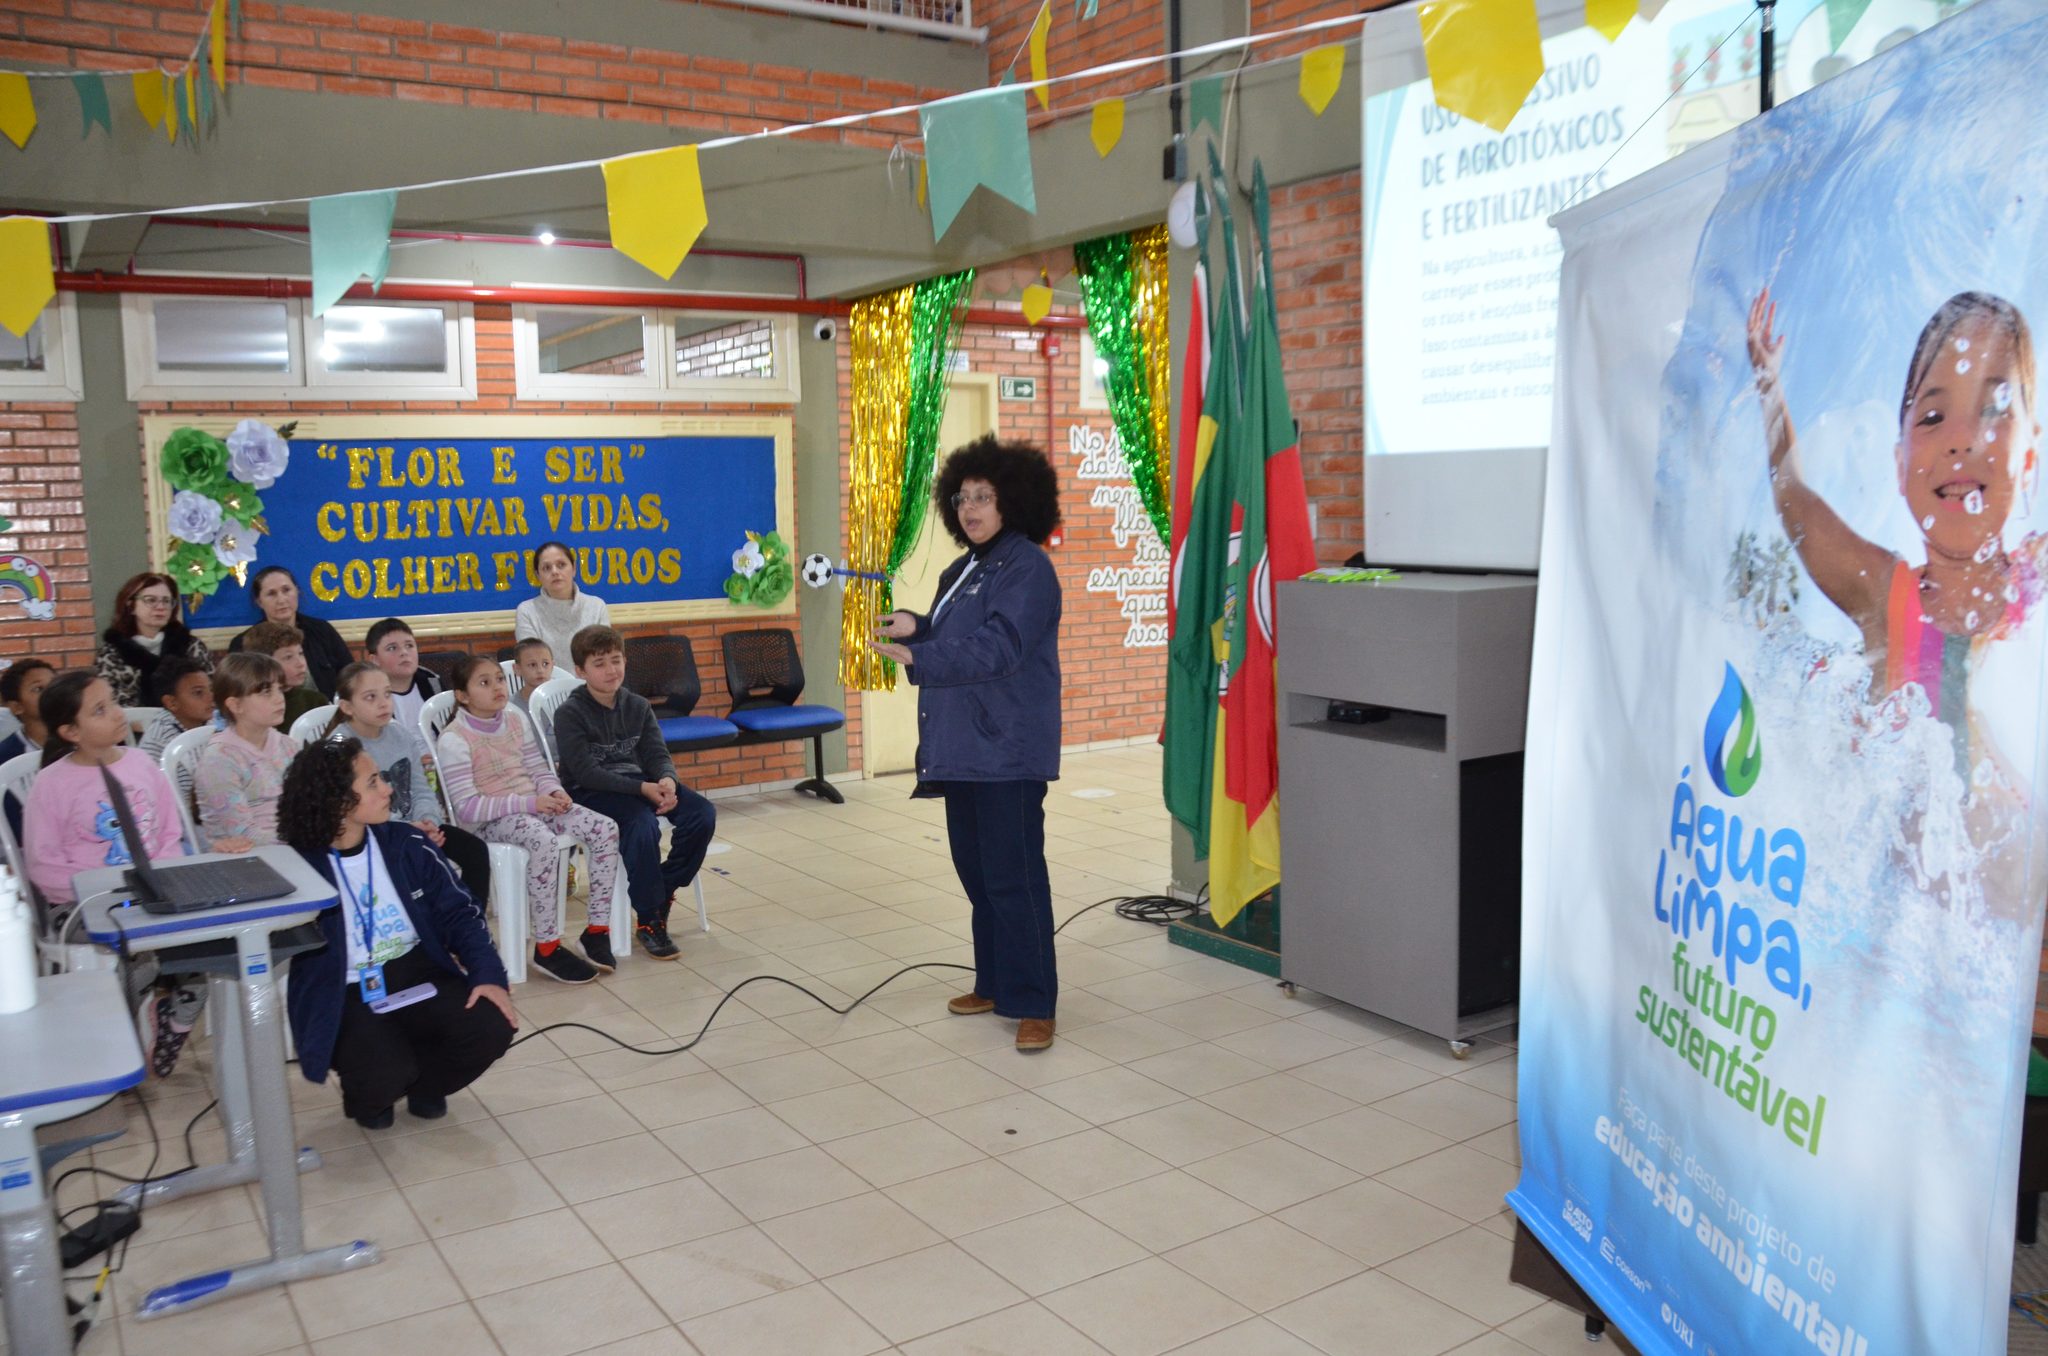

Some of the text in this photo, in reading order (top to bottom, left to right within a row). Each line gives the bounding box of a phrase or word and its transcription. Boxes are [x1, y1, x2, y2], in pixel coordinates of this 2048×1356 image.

[1421, 153, 1446, 188] DE
[1421, 208, 1433, 241] E
[1442, 248, 1528, 276] agricultura,
[1421, 281, 1480, 302] carregar
[1483, 274, 1523, 292] esses
[1421, 314, 1437, 328] os
[1451, 329, 1528, 351] contamina
[1421, 363, 1466, 379] causar
[1421, 384, 1497, 405] ambientais
[1072, 428, 1102, 451] No
[490, 445, 518, 486] E
[316, 492, 670, 543] CULTIVAR VIDAS,
[309, 547, 682, 603] COLHER FUUROS
[1090, 562, 1169, 598] especia
[1123, 596, 1168, 624] qua
[1670, 764, 1807, 909] Água
[1654, 847, 1812, 1012] Limpa,
[1671, 940, 1777, 1053] futuro
[1634, 984, 1827, 1156] sustentável
[1594, 1115, 1695, 1228] educação
[1617, 1087, 1838, 1294] Faça parte deste projeto de
[1671, 1310, 1695, 1349] URI
